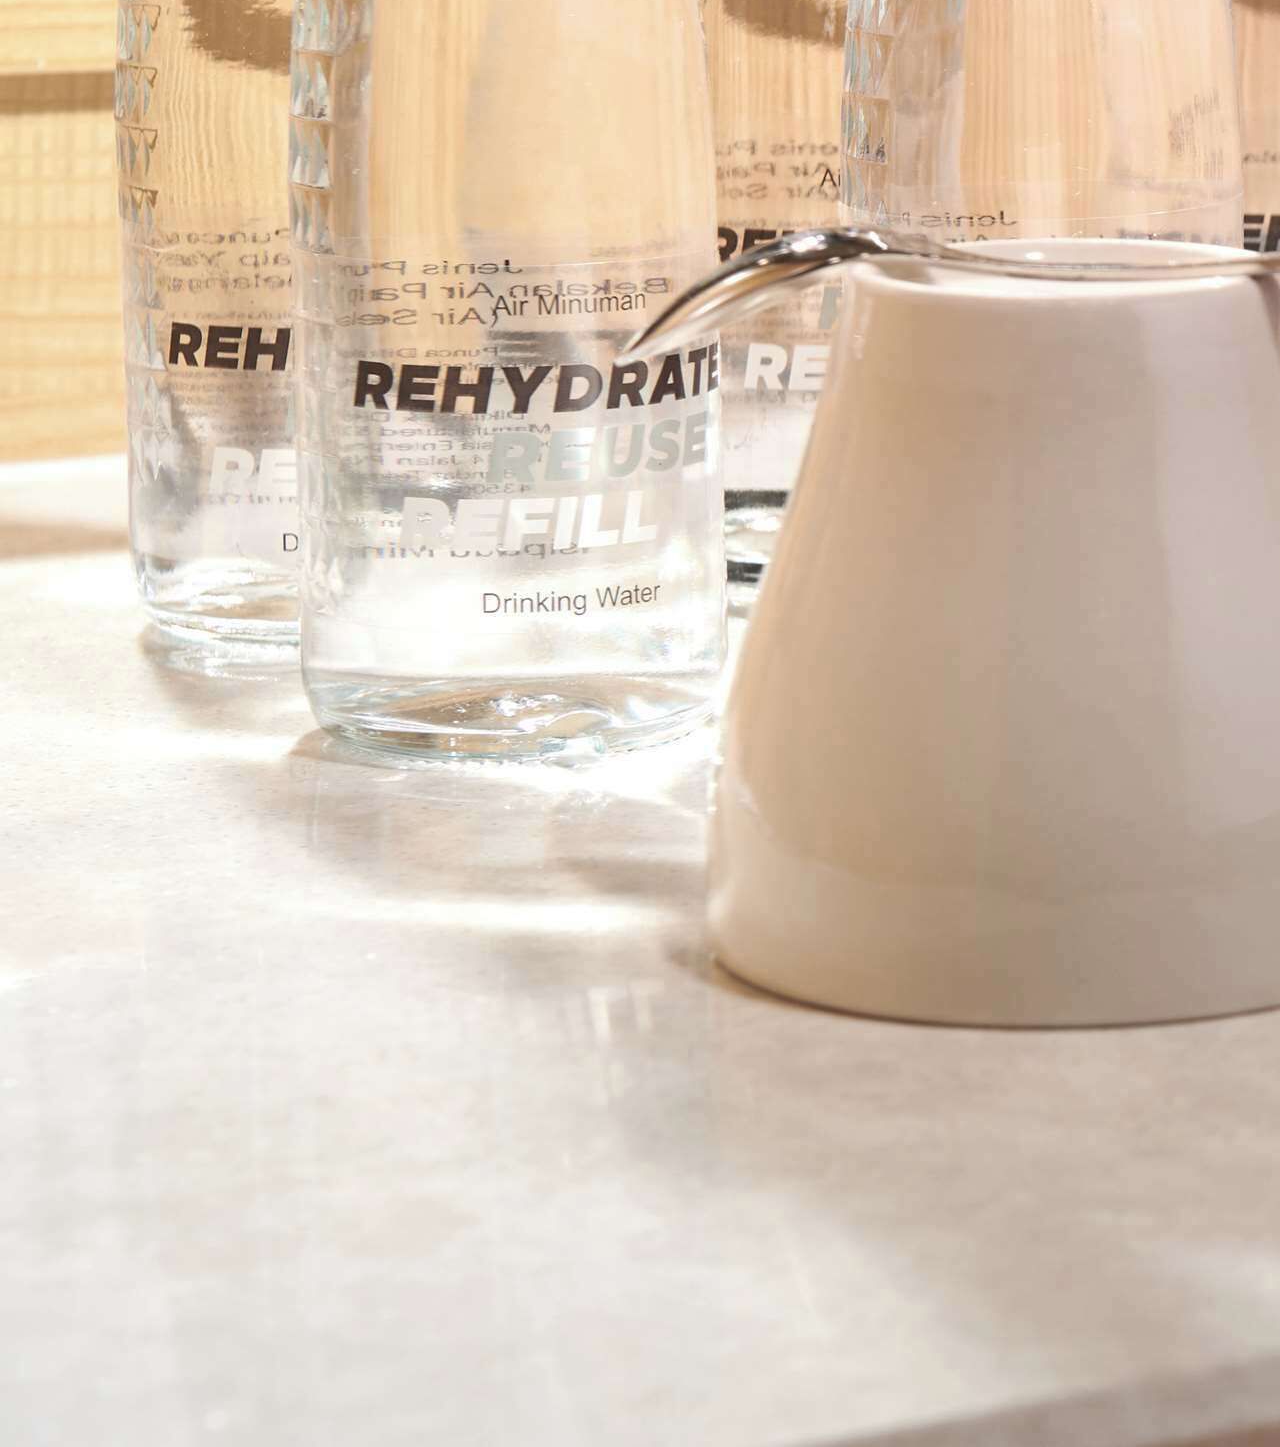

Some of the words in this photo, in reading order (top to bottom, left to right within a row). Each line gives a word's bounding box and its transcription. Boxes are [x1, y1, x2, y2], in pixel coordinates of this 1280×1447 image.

[492, 294, 528, 317] Air
[538, 291, 647, 316] Minuman
[353, 341, 720, 416] REHYDRATE
[483, 409, 708, 485] REUSE
[400, 489, 657, 554] REFILL
[482, 590, 588, 616] Drinking
[596, 584, 661, 608] Water
